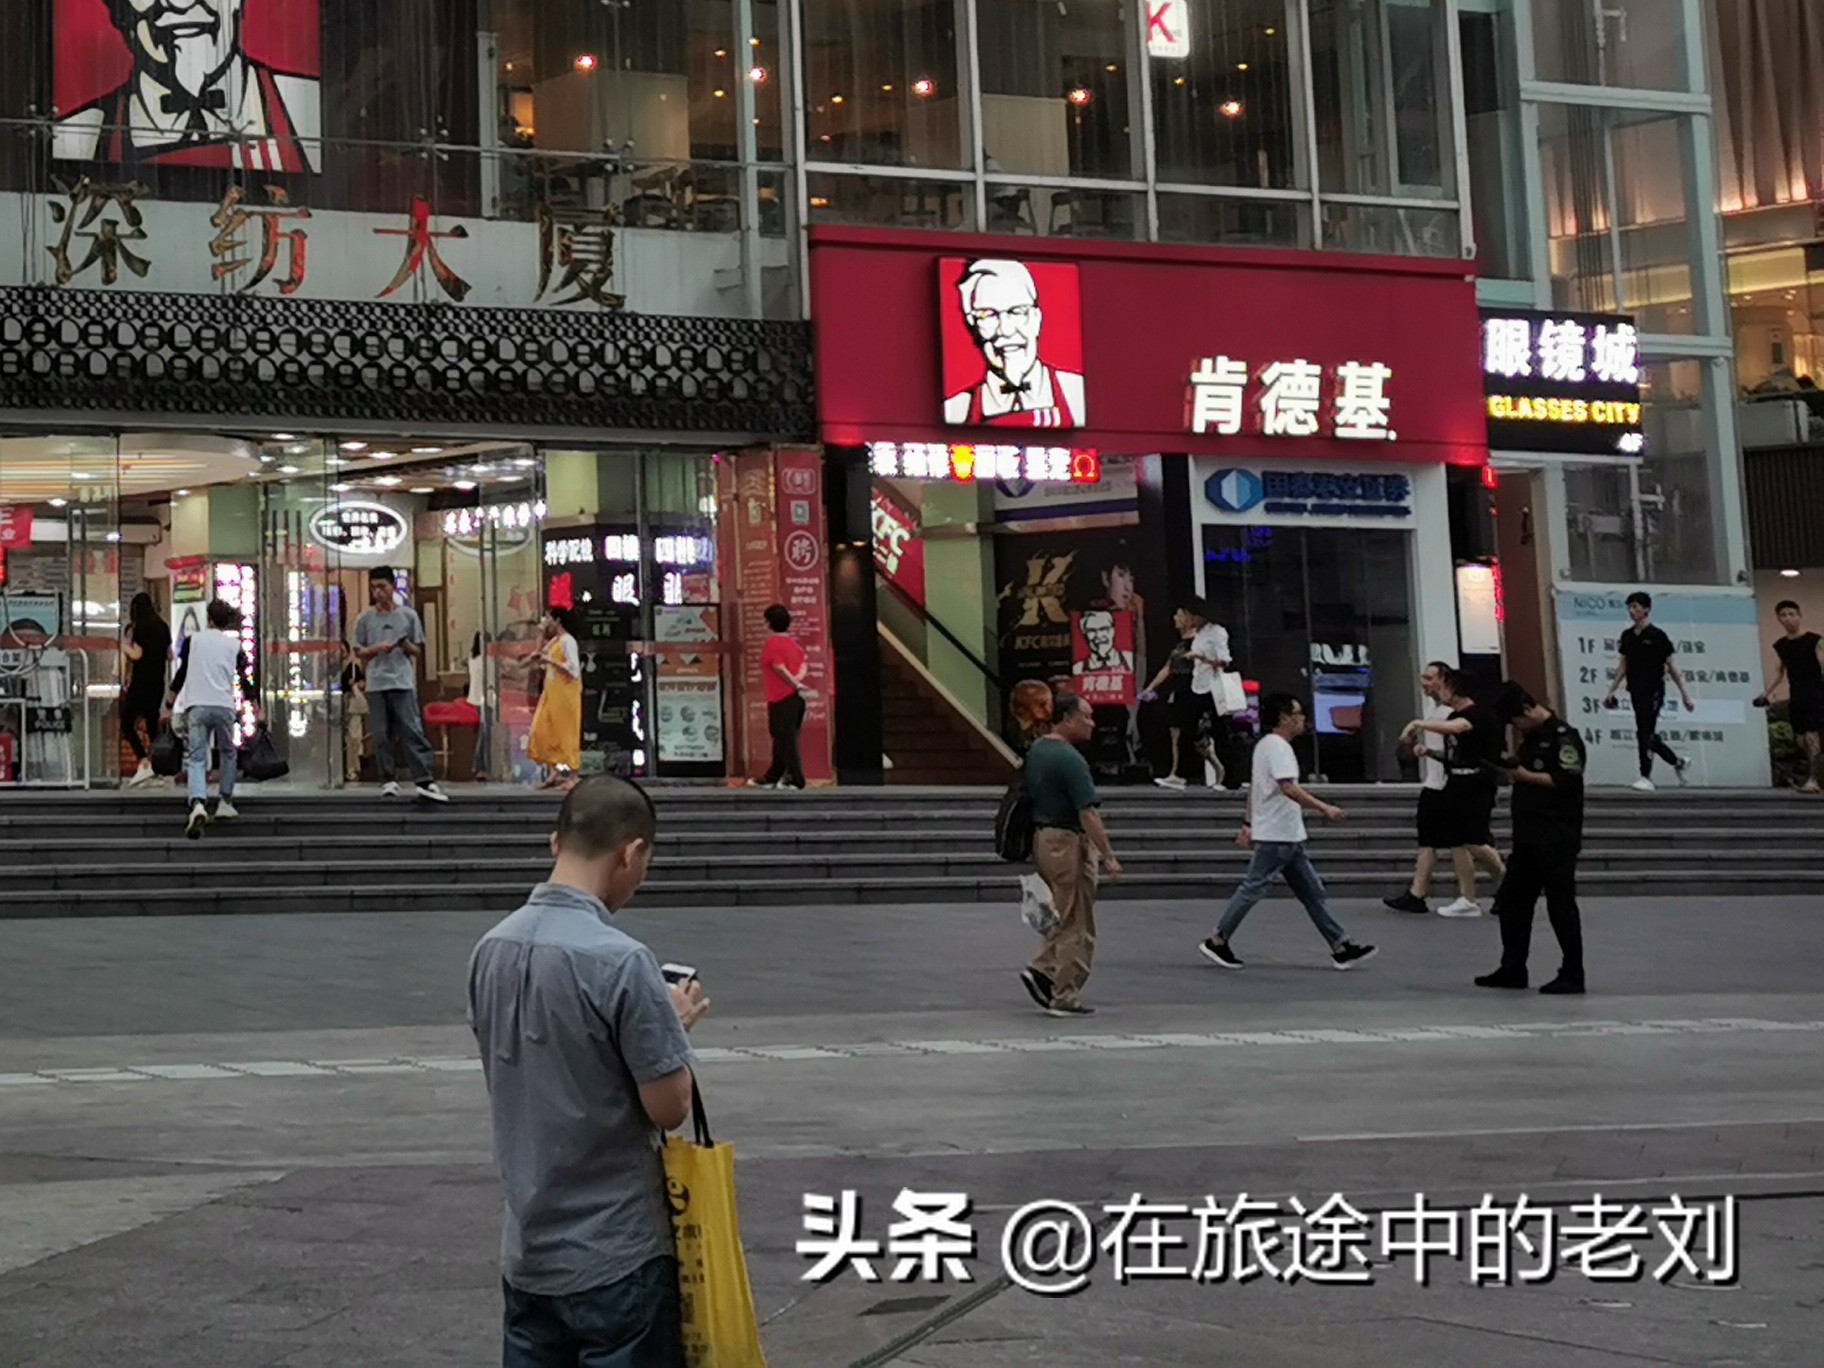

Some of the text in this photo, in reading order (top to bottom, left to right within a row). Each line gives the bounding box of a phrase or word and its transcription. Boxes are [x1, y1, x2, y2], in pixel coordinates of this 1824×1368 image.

[45, 173, 628, 309] 深纺大厦
[1484, 317, 1640, 385] 眼镜城
[1190, 355, 1393, 441] 肯德基
[1487, 394, 1642, 425] GLASSES CITY
[789, 537, 813, 566] 聘
[1577, 636, 1596, 654] 1F
[1579, 666, 1598, 683] 2F
[1581, 696, 1600, 714] 3F
